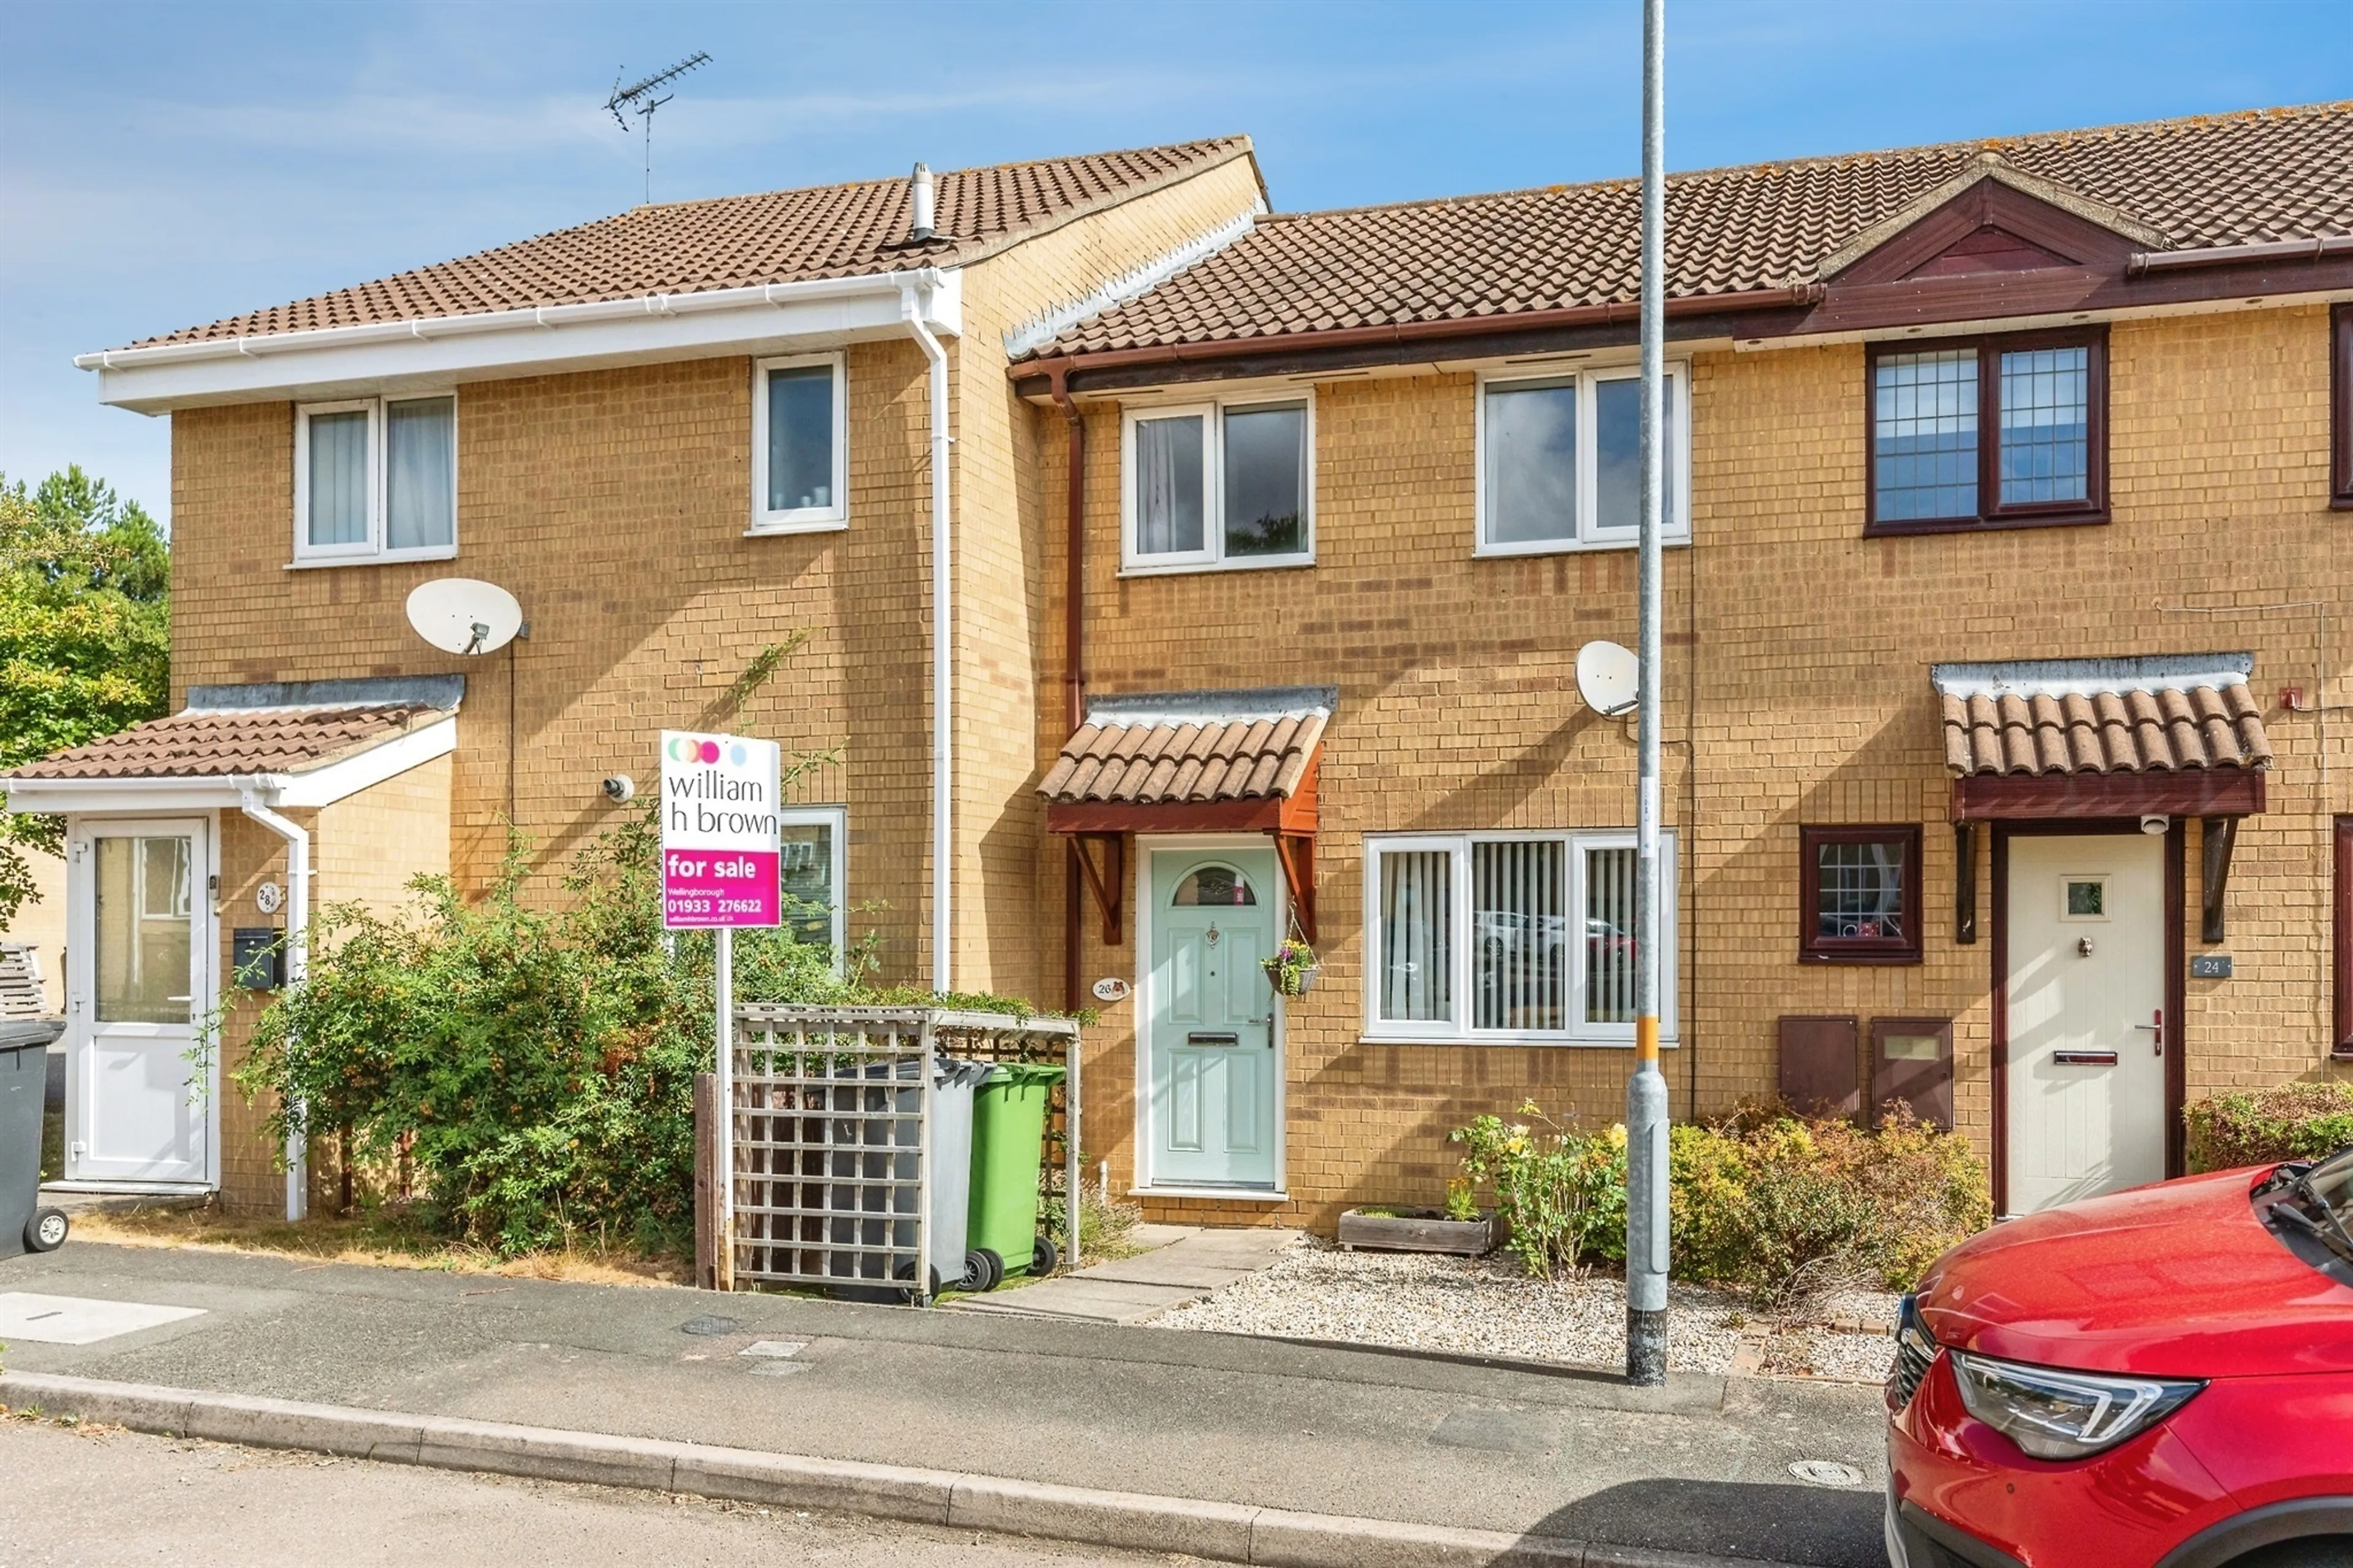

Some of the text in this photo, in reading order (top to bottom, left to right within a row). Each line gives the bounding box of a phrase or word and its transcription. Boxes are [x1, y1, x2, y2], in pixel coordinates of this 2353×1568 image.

[669, 770, 762, 801] william
[672, 801, 777, 835] h brown
[668, 854, 756, 879] for sale
[259, 889, 271, 906] 28
[668, 888, 724, 898] Wellingborough
[668, 899, 762, 914] 01933 276622
[2204, 961, 2219, 973] 24
[1099, 984, 1111, 994] 26
